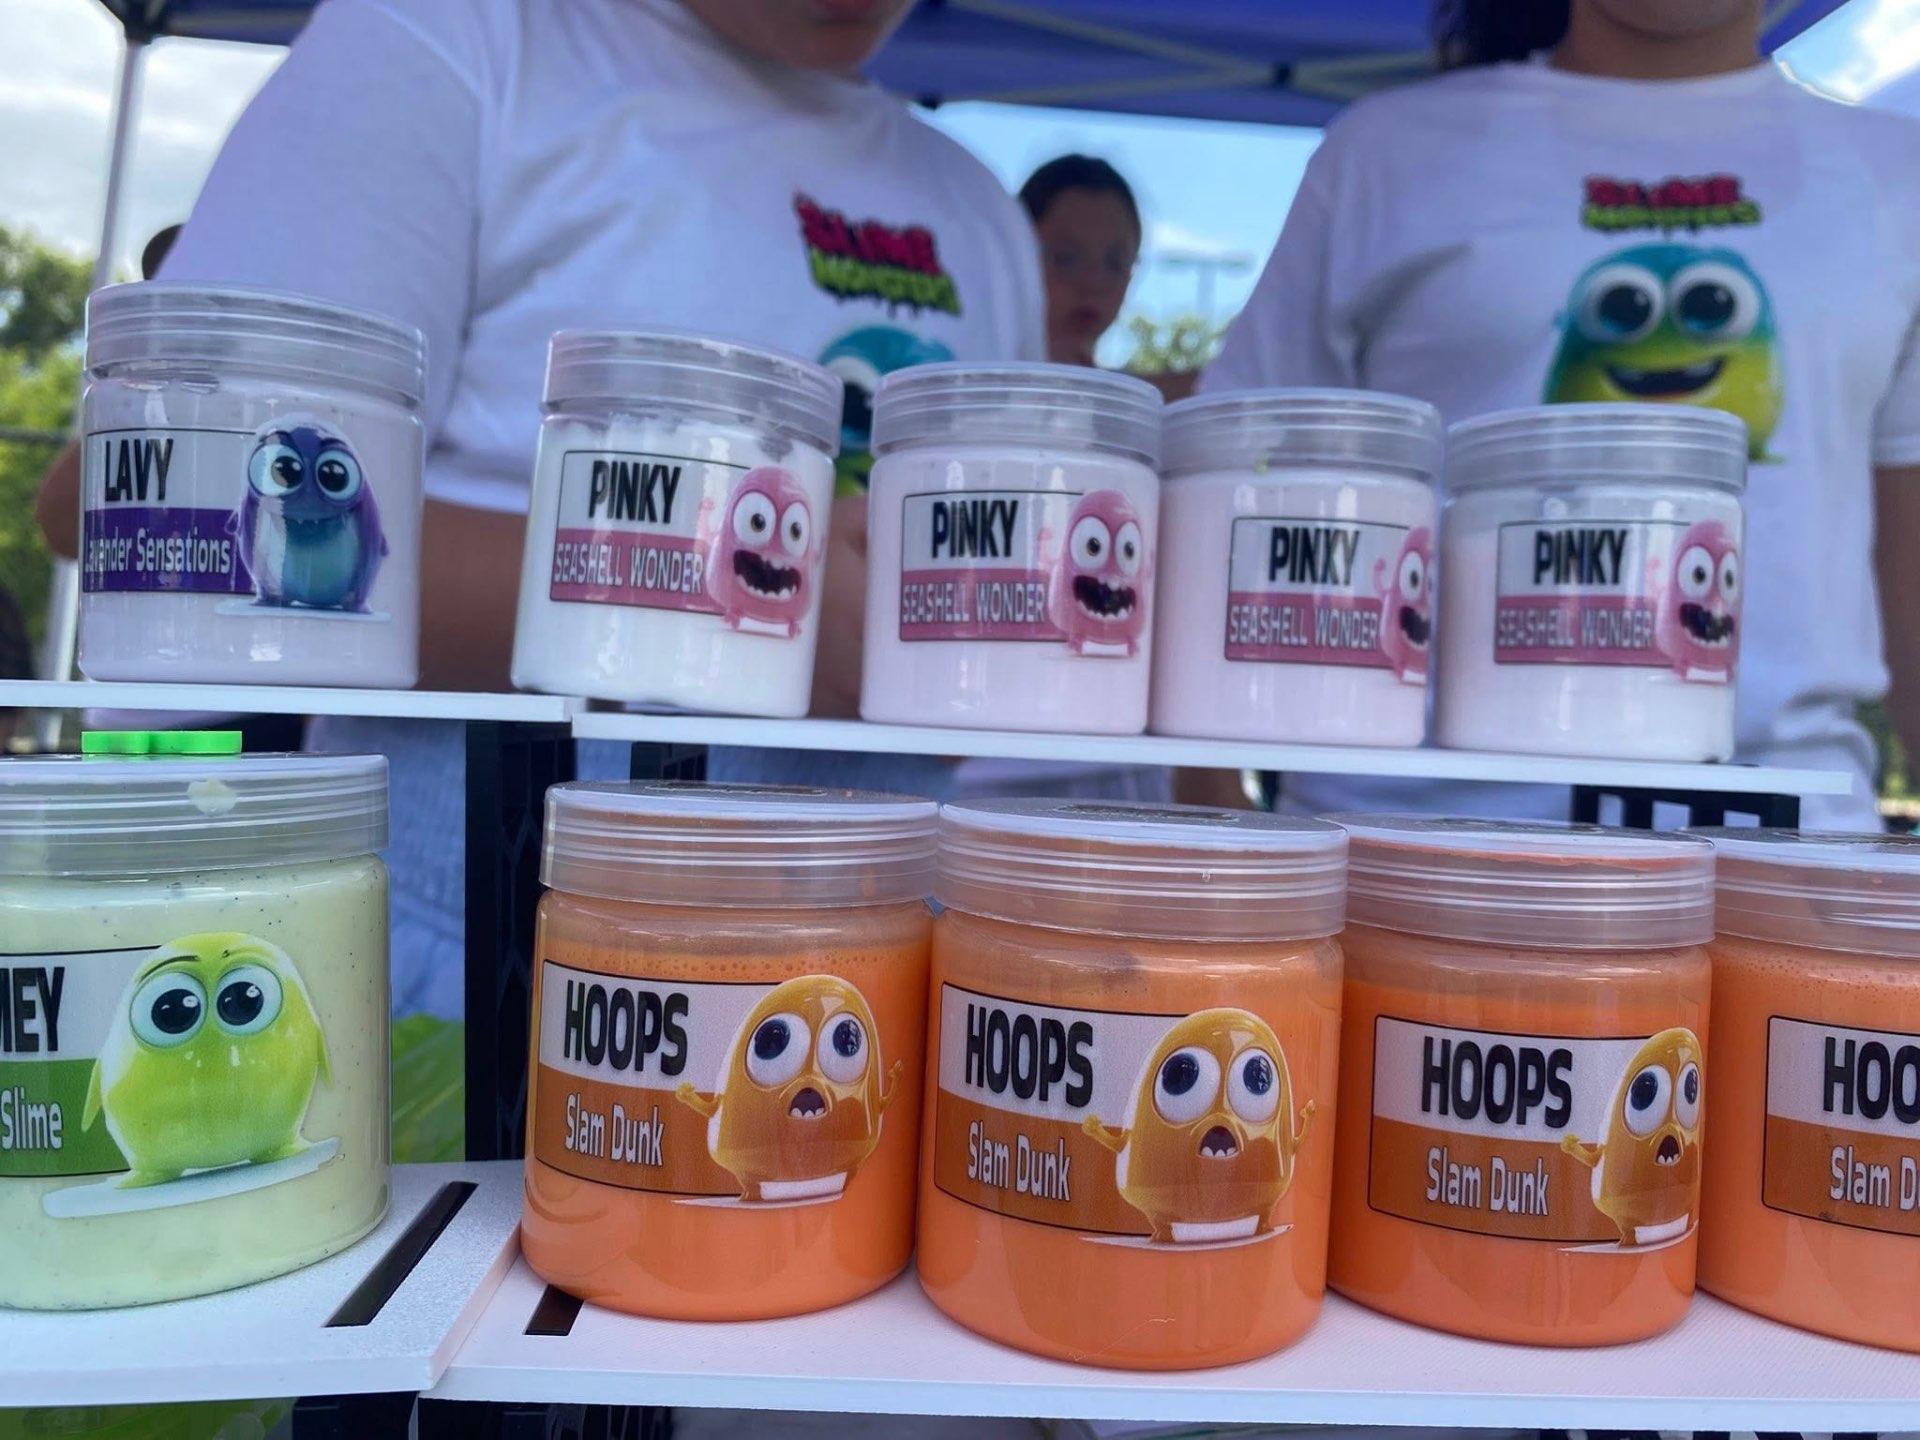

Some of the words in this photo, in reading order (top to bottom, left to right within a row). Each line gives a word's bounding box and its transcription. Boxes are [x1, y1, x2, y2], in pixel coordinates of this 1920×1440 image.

[105, 439, 173, 501] LAVY
[588, 460, 682, 525] PINKY
[136, 526, 231, 574] Sensations
[931, 501, 1018, 560] PINKY
[1269, 527, 1359, 586] PINKY
[1534, 530, 1627, 586] PINKY
[554, 541, 623, 587] SEASHELL
[630, 547, 704, 595] WONDER
[902, 583, 970, 623] SEASHELL
[976, 582, 1046, 623] WONDER
[1229, 605, 1308, 648] SEASHELL
[1314, 608, 1379, 651] WONDER
[1498, 610, 1574, 649] SEASHELL
[1580, 609, 1653, 650] WONDER
[564, 979, 689, 1077] HOOPS
[966, 1003, 1093, 1108] HOOPS
[1421, 1035, 1573, 1129] HOOPS
[1, 1086, 63, 1150] Slime
[564, 1093, 605, 1158] Slam
[610, 1105, 663, 1167] Dunk
[967, 1120, 1009, 1189] Slam
[1015, 1133, 1071, 1201] Dunk
[1426, 1145, 1482, 1210] Slam
[1488, 1156, 1549, 1217] Dunk
[1830, 1144, 1890, 1208] Slam
